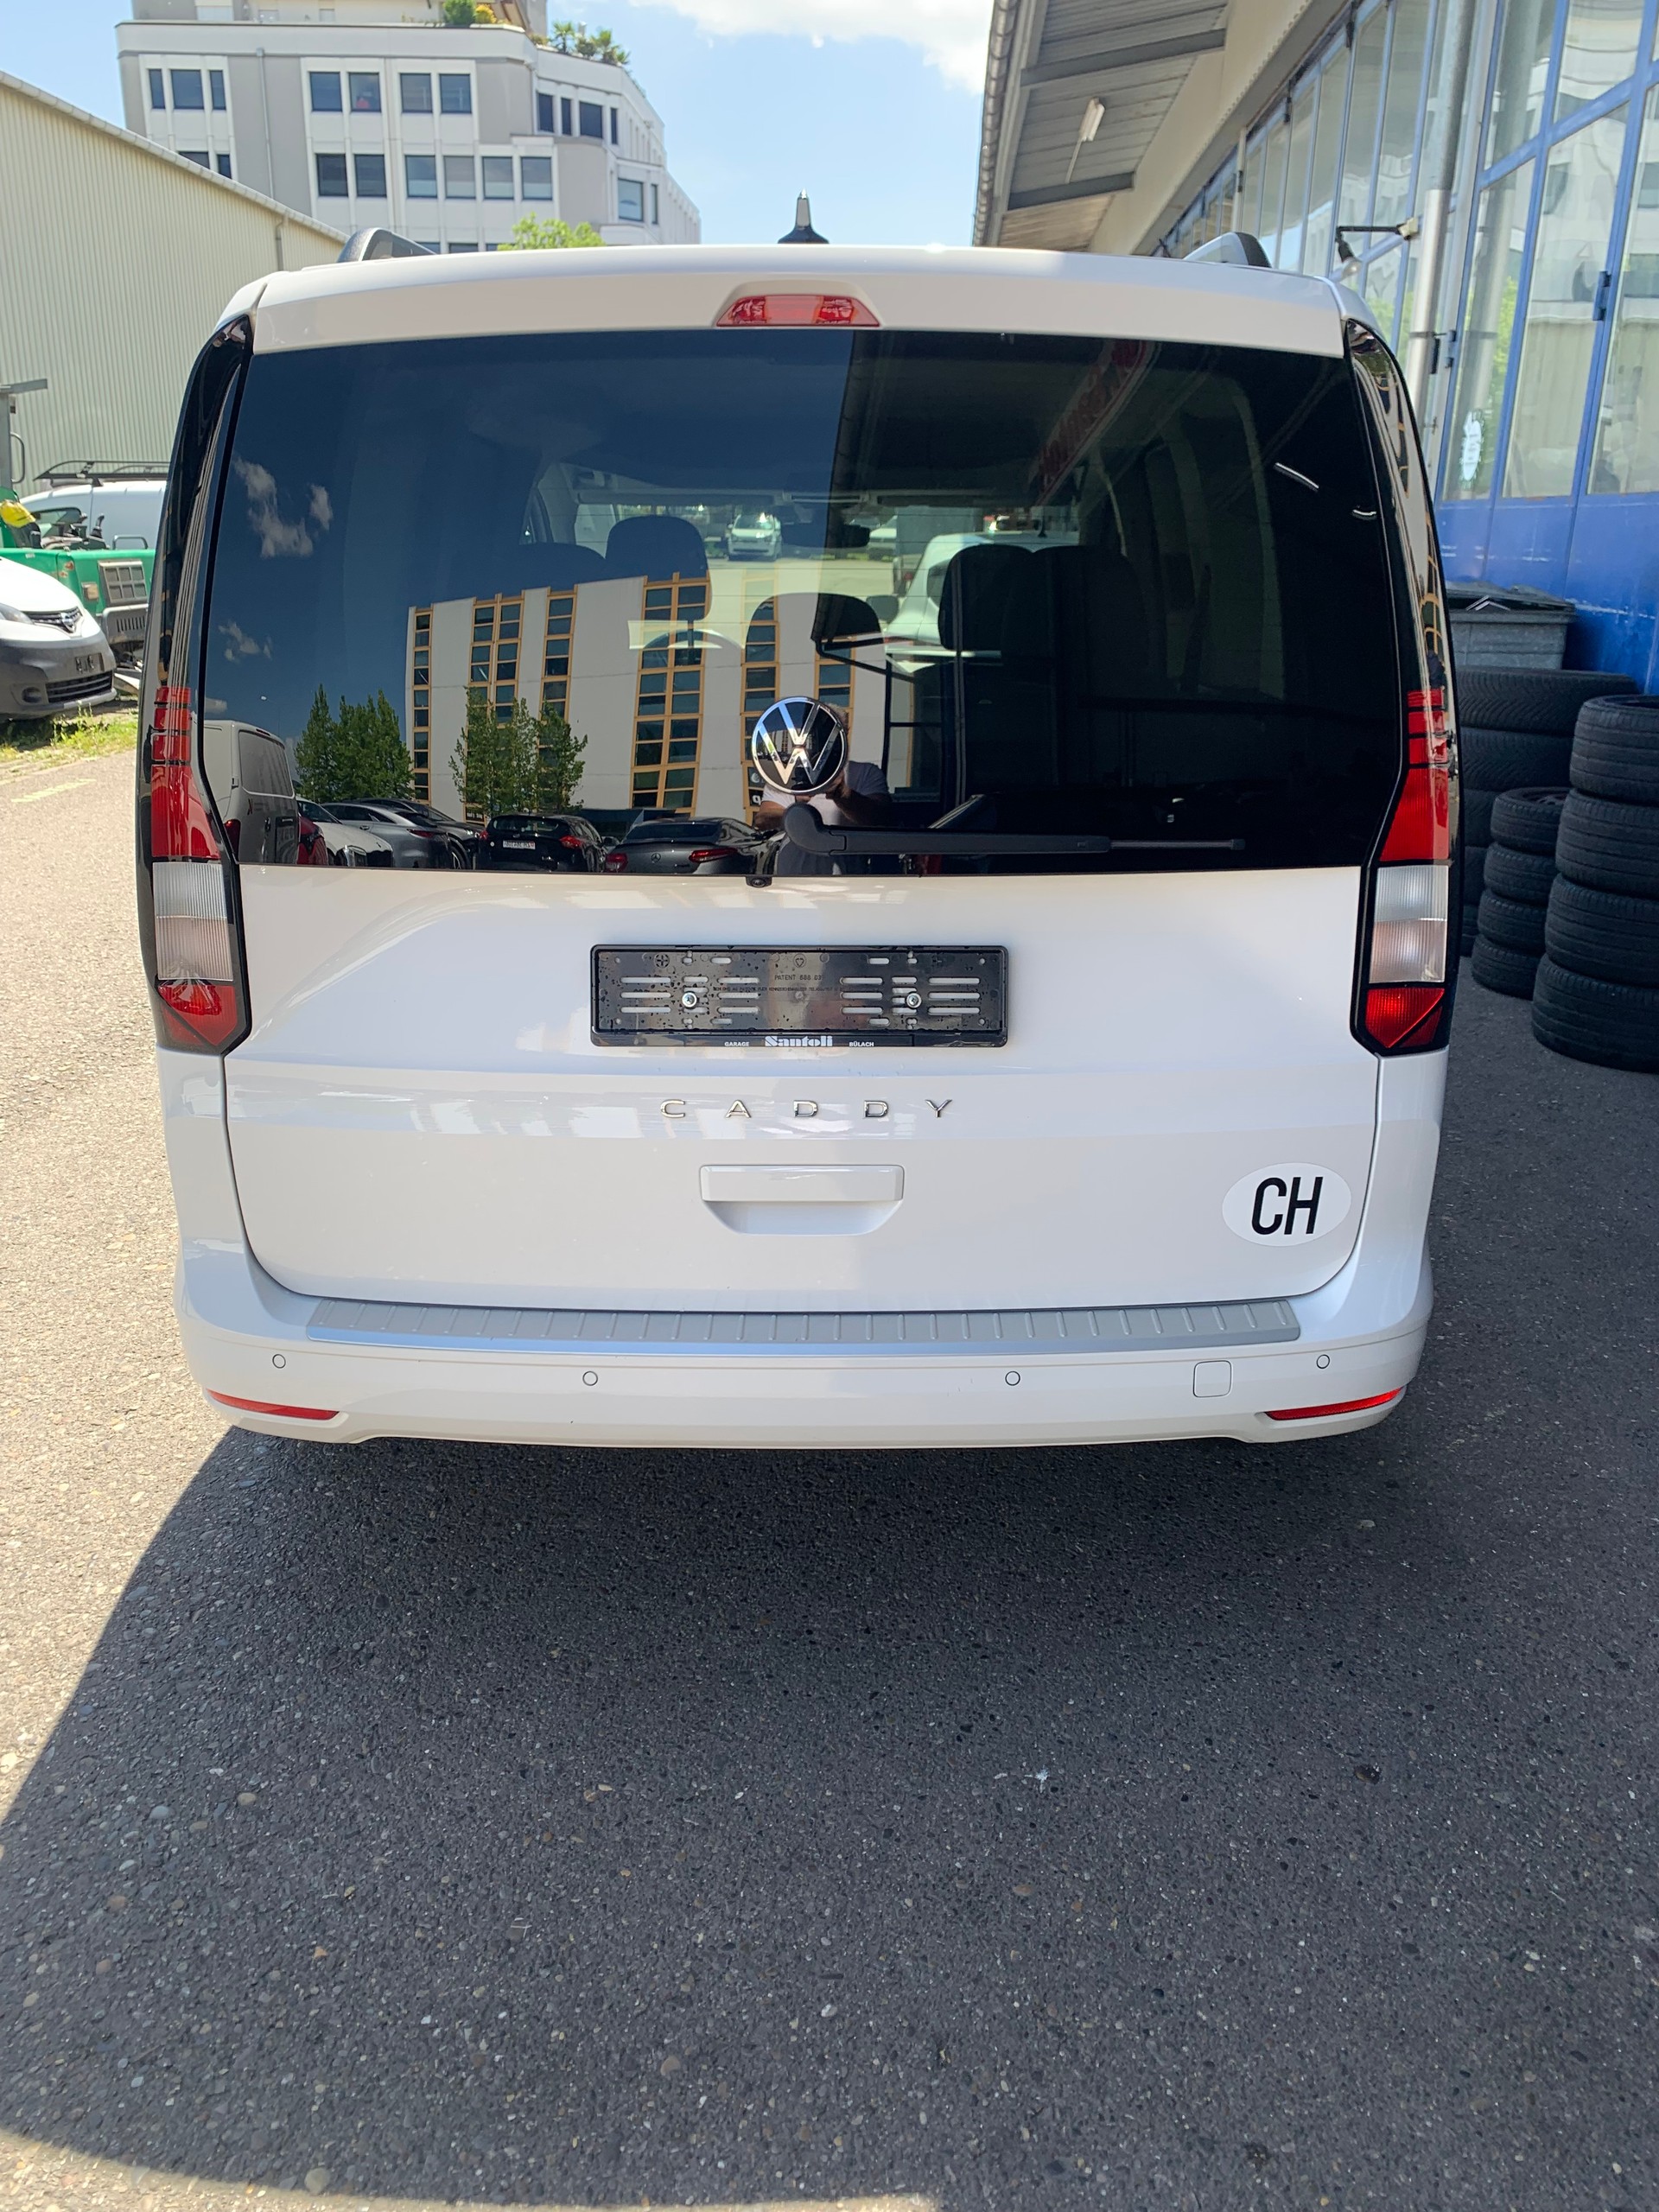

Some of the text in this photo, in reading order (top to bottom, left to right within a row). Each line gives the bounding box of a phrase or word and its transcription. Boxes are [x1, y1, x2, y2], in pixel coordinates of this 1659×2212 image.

[752, 696, 848, 793] VW
[765, 1035, 833, 1047] Santoli
[661, 1099, 953, 1119] CADDY
[1251, 1176, 1323, 1236] CH
